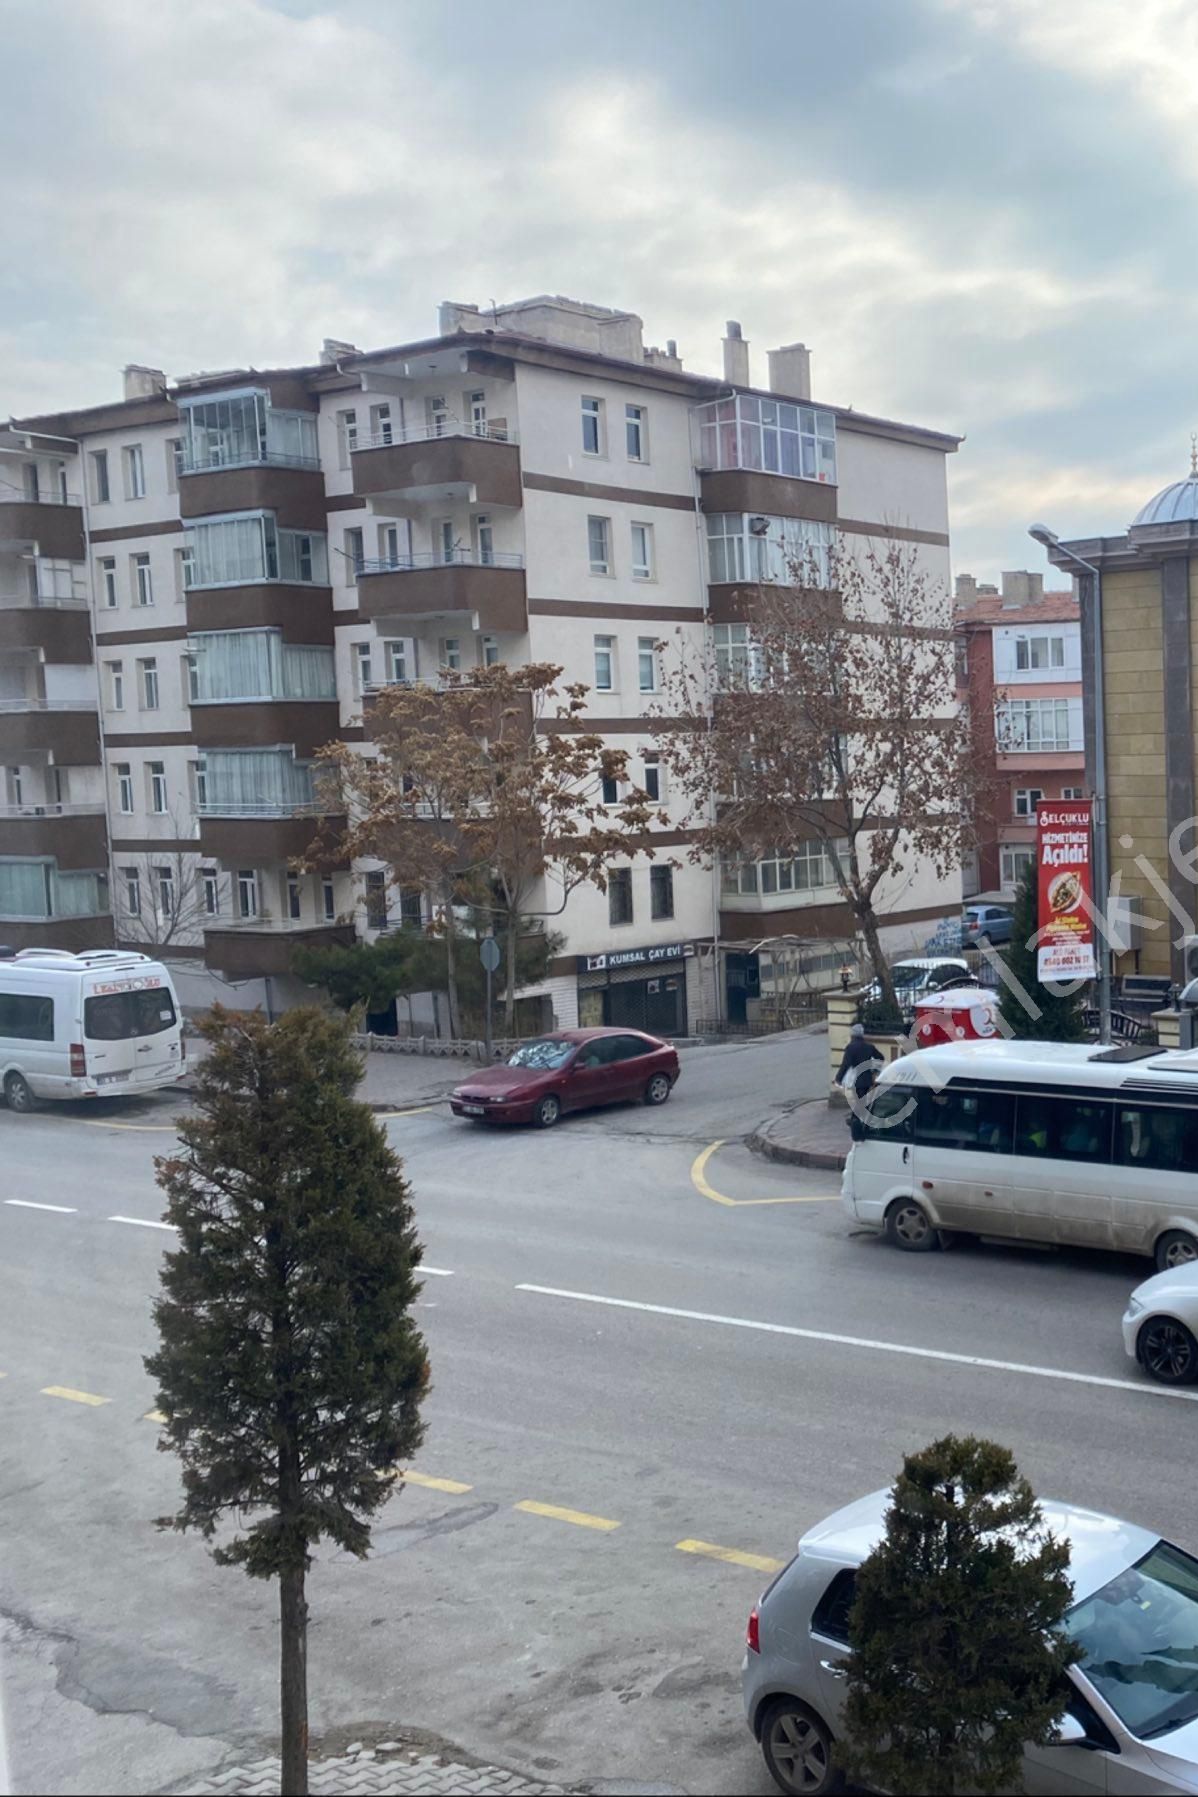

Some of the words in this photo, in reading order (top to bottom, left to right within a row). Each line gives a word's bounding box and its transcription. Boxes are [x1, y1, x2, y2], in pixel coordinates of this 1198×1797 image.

[1040, 811, 1089, 827] SELÇUKLU
[1042, 844, 1088, 867] Açıldı!
[609, 953, 646, 966] KUMSAL
[648, 949, 665, 961] ÇAY
[667, 944, 681, 956] EVİ
